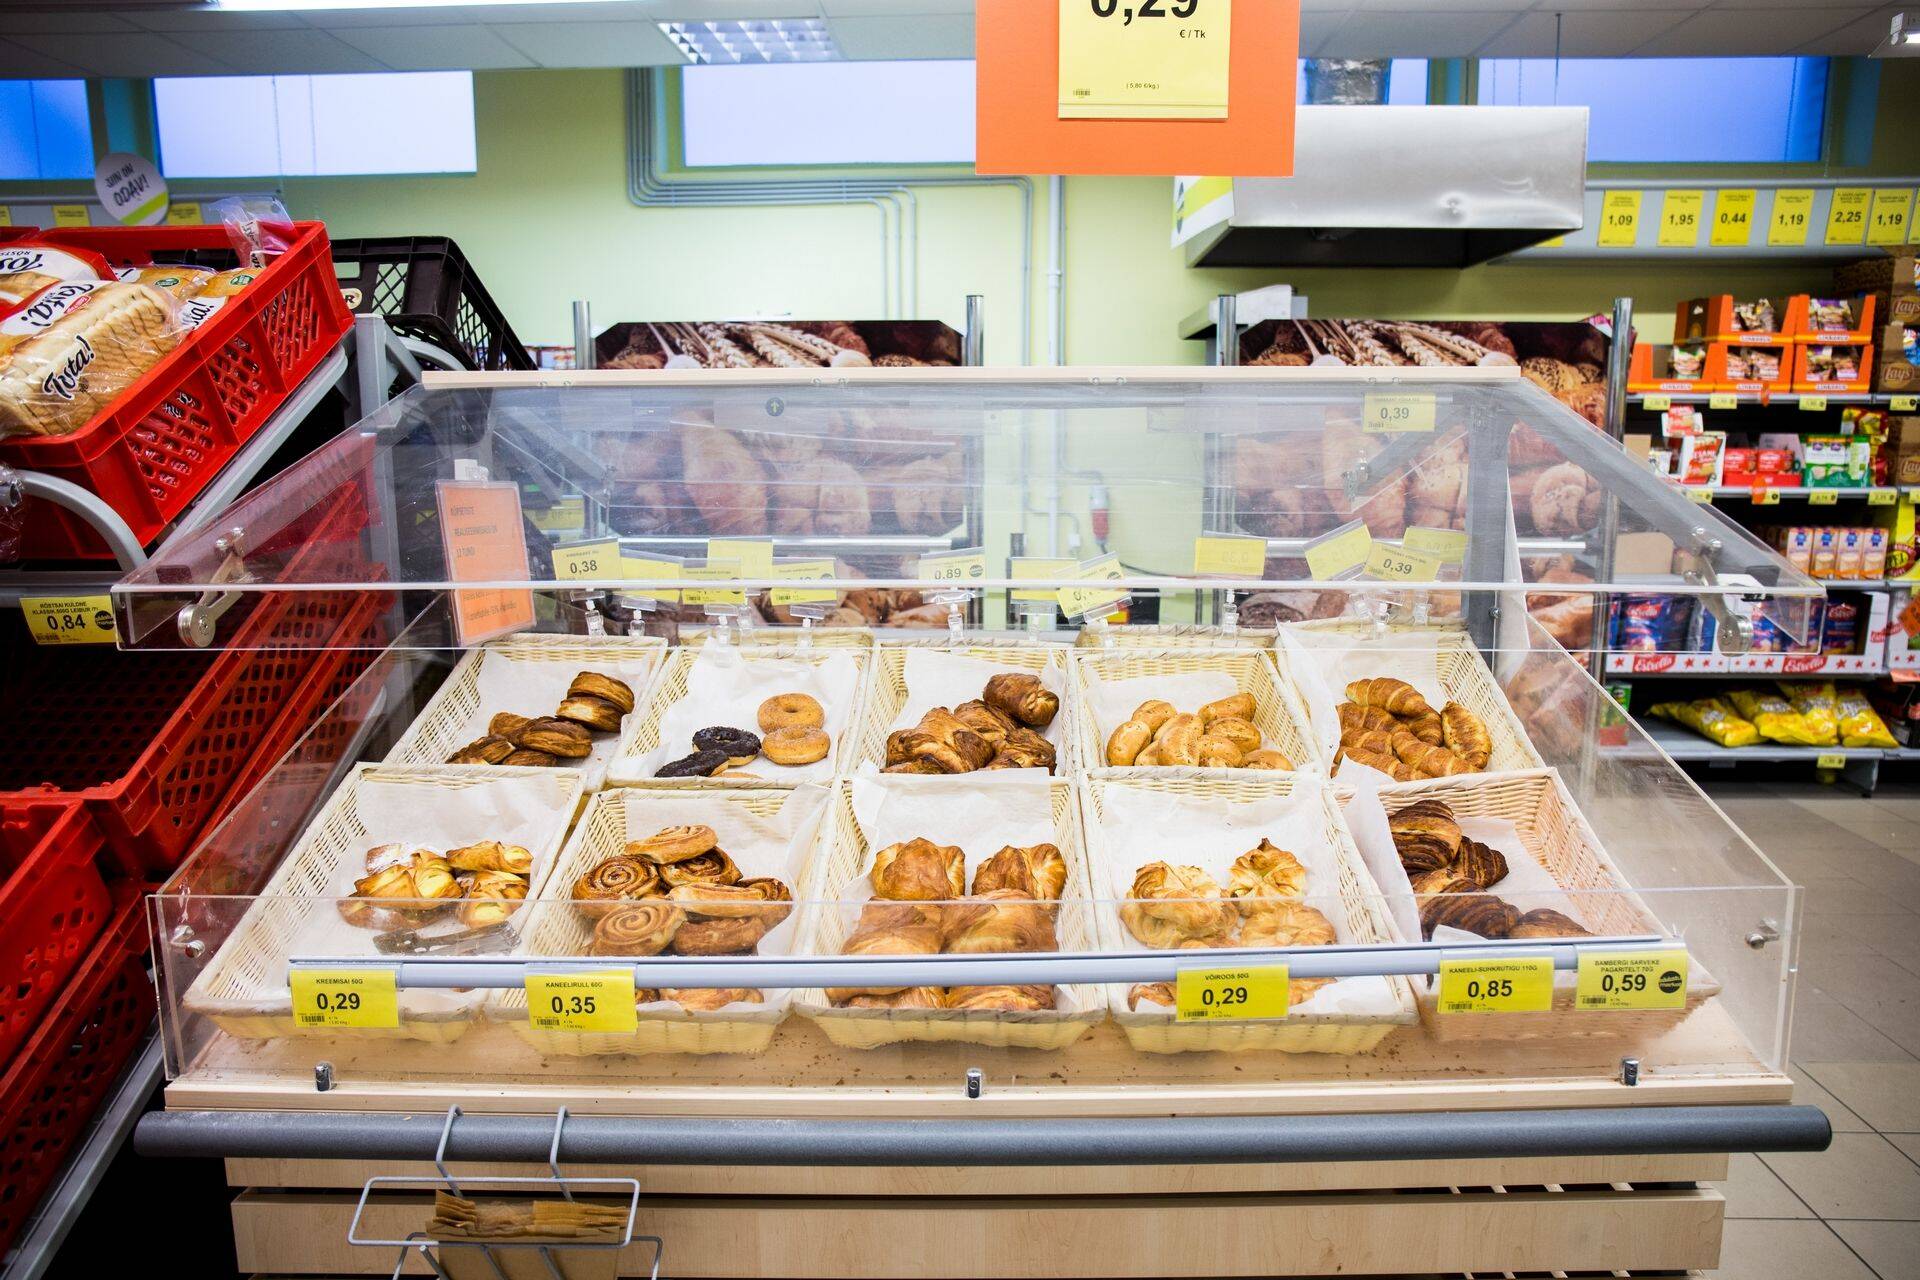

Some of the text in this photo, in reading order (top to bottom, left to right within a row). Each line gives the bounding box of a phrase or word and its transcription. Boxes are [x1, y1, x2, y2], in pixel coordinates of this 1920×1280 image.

[1608, 214, 1633, 227] 1,09
[1669, 214, 1694, 226] 1,95
[1720, 213, 1746, 225] 0,44
[1779, 214, 1804, 226] 1,19
[1835, 211, 1862, 224] 2,25
[1877, 213, 1903, 226] 1,19
[43, 334, 95, 399] Tosta!
[1380, 407, 1410, 423] 0,39
[569, 560, 598, 576] 0,38
[1382, 558, 1413, 575] 0,39
[47, 613, 86, 632] 0,84
[1467, 980, 1513, 1000] 0,85
[1602, 974, 1646, 995] 0,59
[317, 992, 360, 1012] 0,29
[1202, 987, 1248, 1007] 0,29
[551, 996, 596, 1016] 0,35
